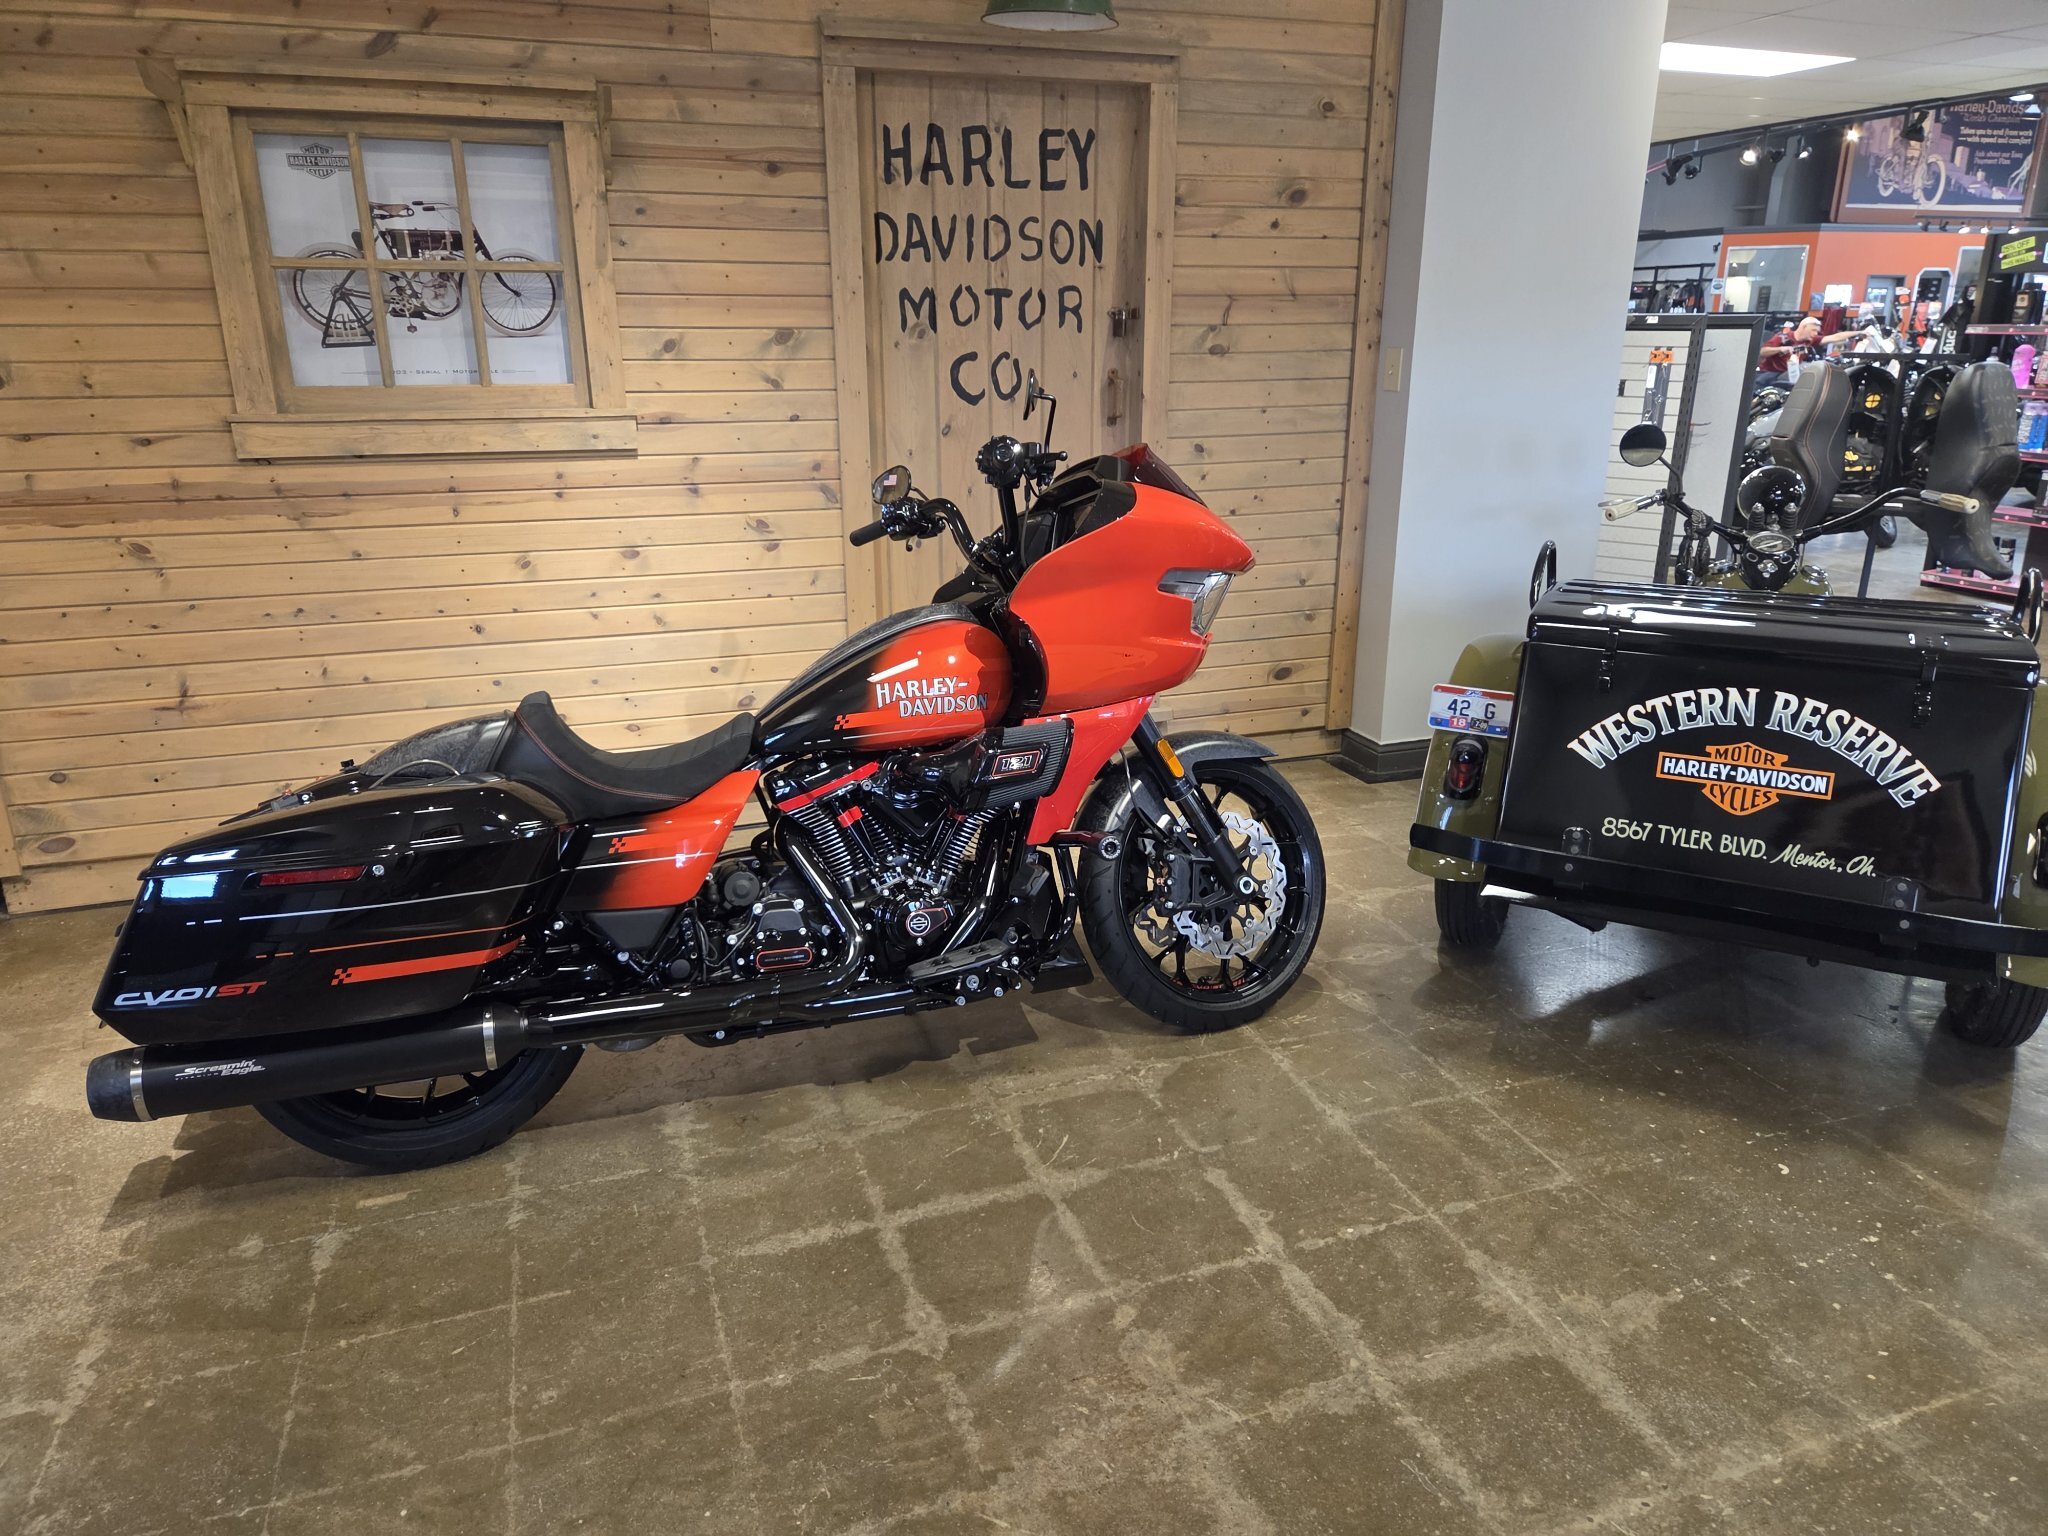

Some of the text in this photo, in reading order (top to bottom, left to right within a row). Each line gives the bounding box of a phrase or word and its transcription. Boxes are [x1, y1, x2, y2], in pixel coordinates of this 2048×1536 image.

[289, 156, 350, 167] HARLEY-DAVIDSON
[304, 145, 330, 155] MOTOR
[883, 122, 1096, 191] HARLEY
[309, 168, 333, 178] CYCLES
[874, 212, 1103, 267] DAVIDSON
[899, 284, 1082, 334] MOTOR
[950, 351, 1022, 406] CO
[876, 676, 968, 709] HARLEY-
[899, 693, 988, 718] DAVIDSON
[1447, 698, 1496, 720] 42 G
[1451, 717, 1467, 727] 18
[1567, 687, 1942, 809] WESTERN RESERVE
[1715, 745, 1775, 766] MOTOR
[1663, 757, 1828, 794] HARLEY-DAVIDSON
[1709, 783, 1772, 812] CYCLES
[1601, 817, 1877, 877] 8567 TYLER BLVD. Mentor, Oh.
[221, 1065, 266, 1077] Eagle
